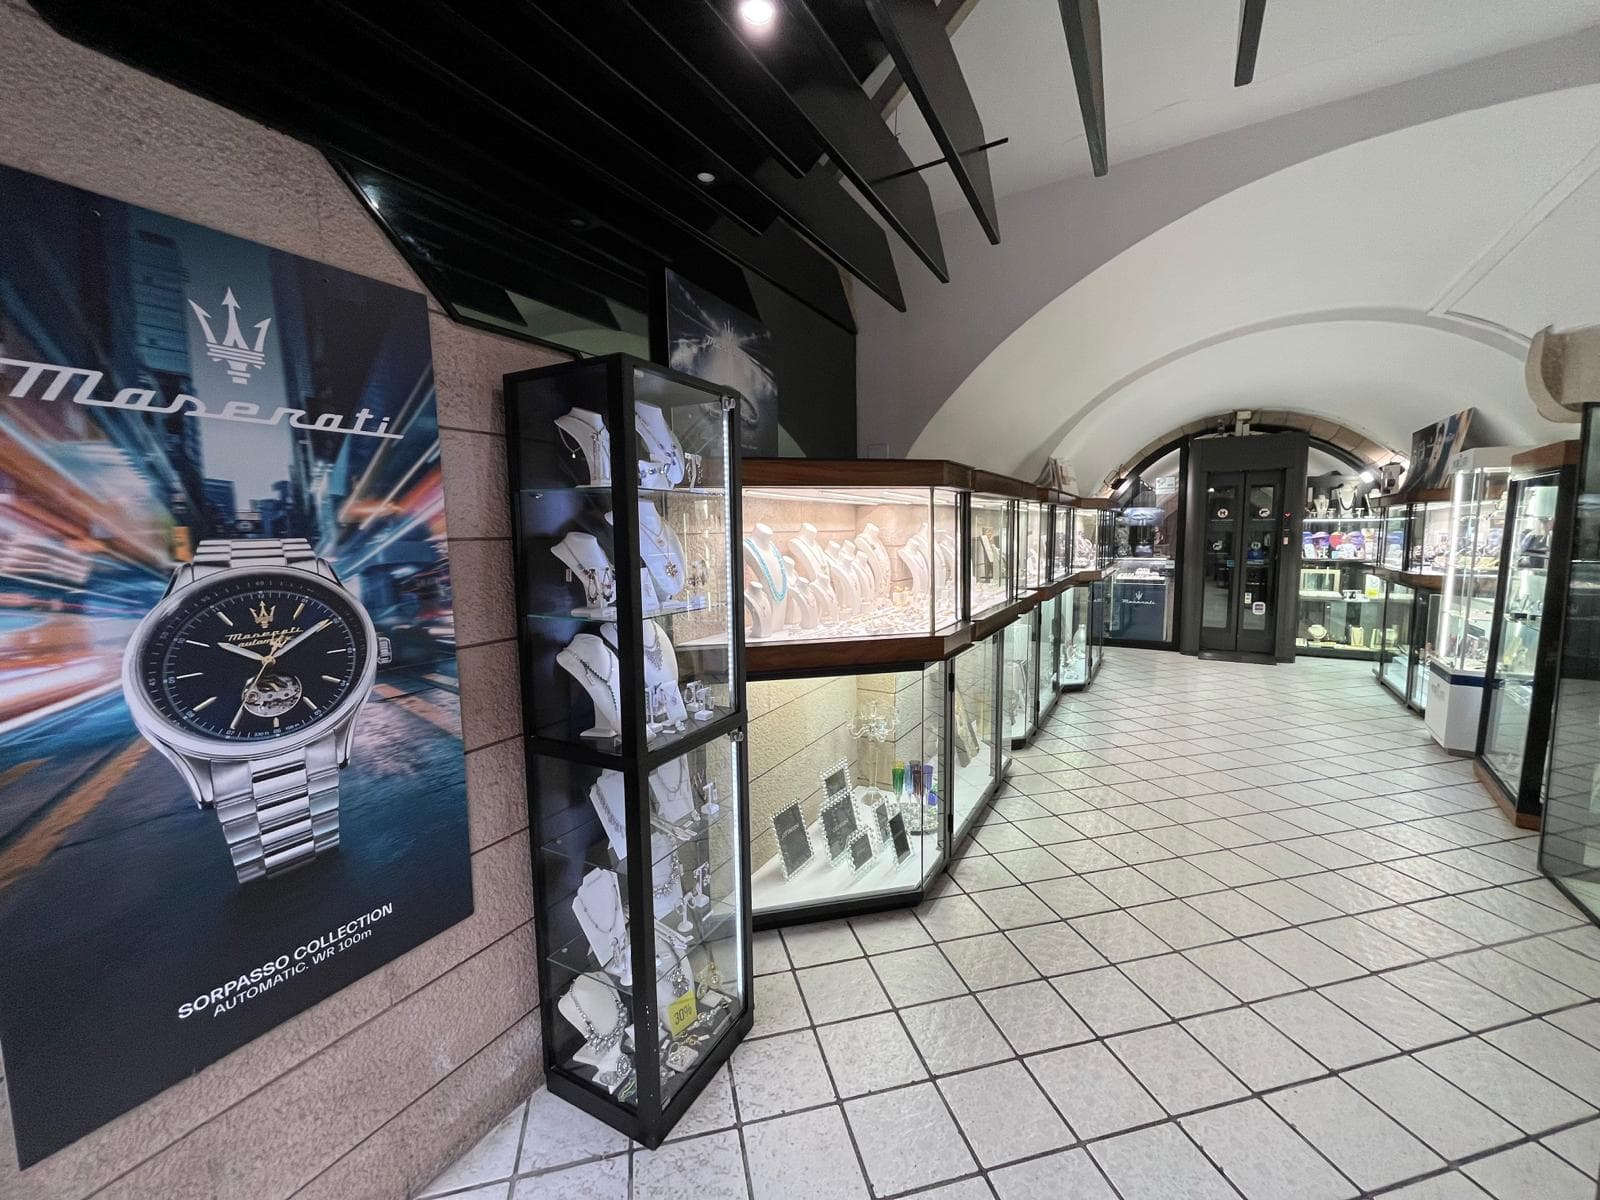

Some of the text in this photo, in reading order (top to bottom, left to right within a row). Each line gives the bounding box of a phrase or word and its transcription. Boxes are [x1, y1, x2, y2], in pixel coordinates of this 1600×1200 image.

[225, 626, 304, 641] Maserati
[177, 902, 393, 1019] SORPASSO COLLECTION
[312, 947, 336, 965] WR
[338, 929, 372, 952] 100m
[673, 1003, 692, 1025] 30%
